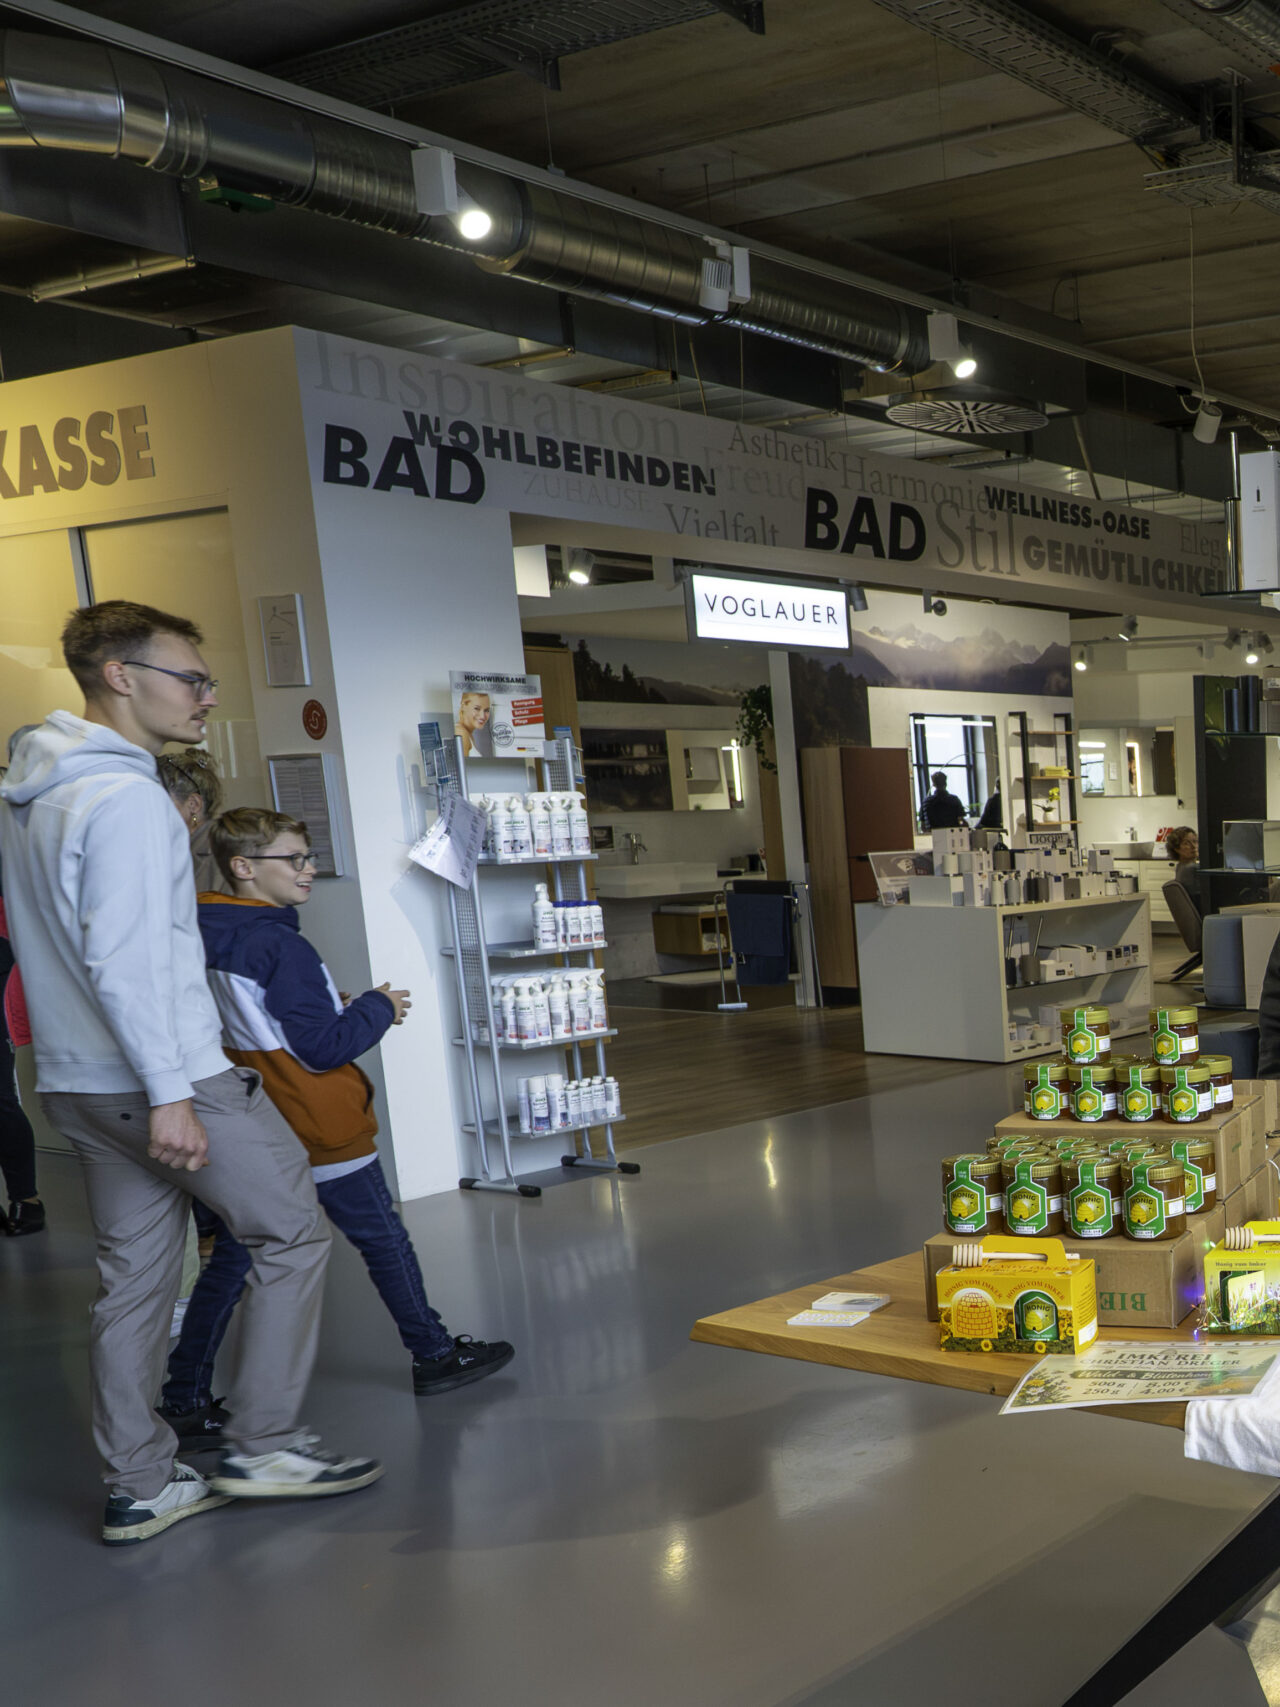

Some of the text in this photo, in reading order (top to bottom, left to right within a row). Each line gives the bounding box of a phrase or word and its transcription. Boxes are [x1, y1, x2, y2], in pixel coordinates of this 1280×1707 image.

[322, 424, 486, 504] BAD
[403, 410, 716, 496] WOHLBEFINDEN
[664, 503, 780, 547] Vielfalt
[804, 486, 927, 562] BAD
[984, 485, 1150, 540] WELLNESS-OASE
[936, 499, 1021, 577] Stil
[704, 593, 837, 624] VOGLAUER
[464, 674, 527, 684] HOCHWIRKSAME
[1026, 1303, 1050, 1312] HONIG
[1117, 1353, 1213, 1361] IMKEREI
